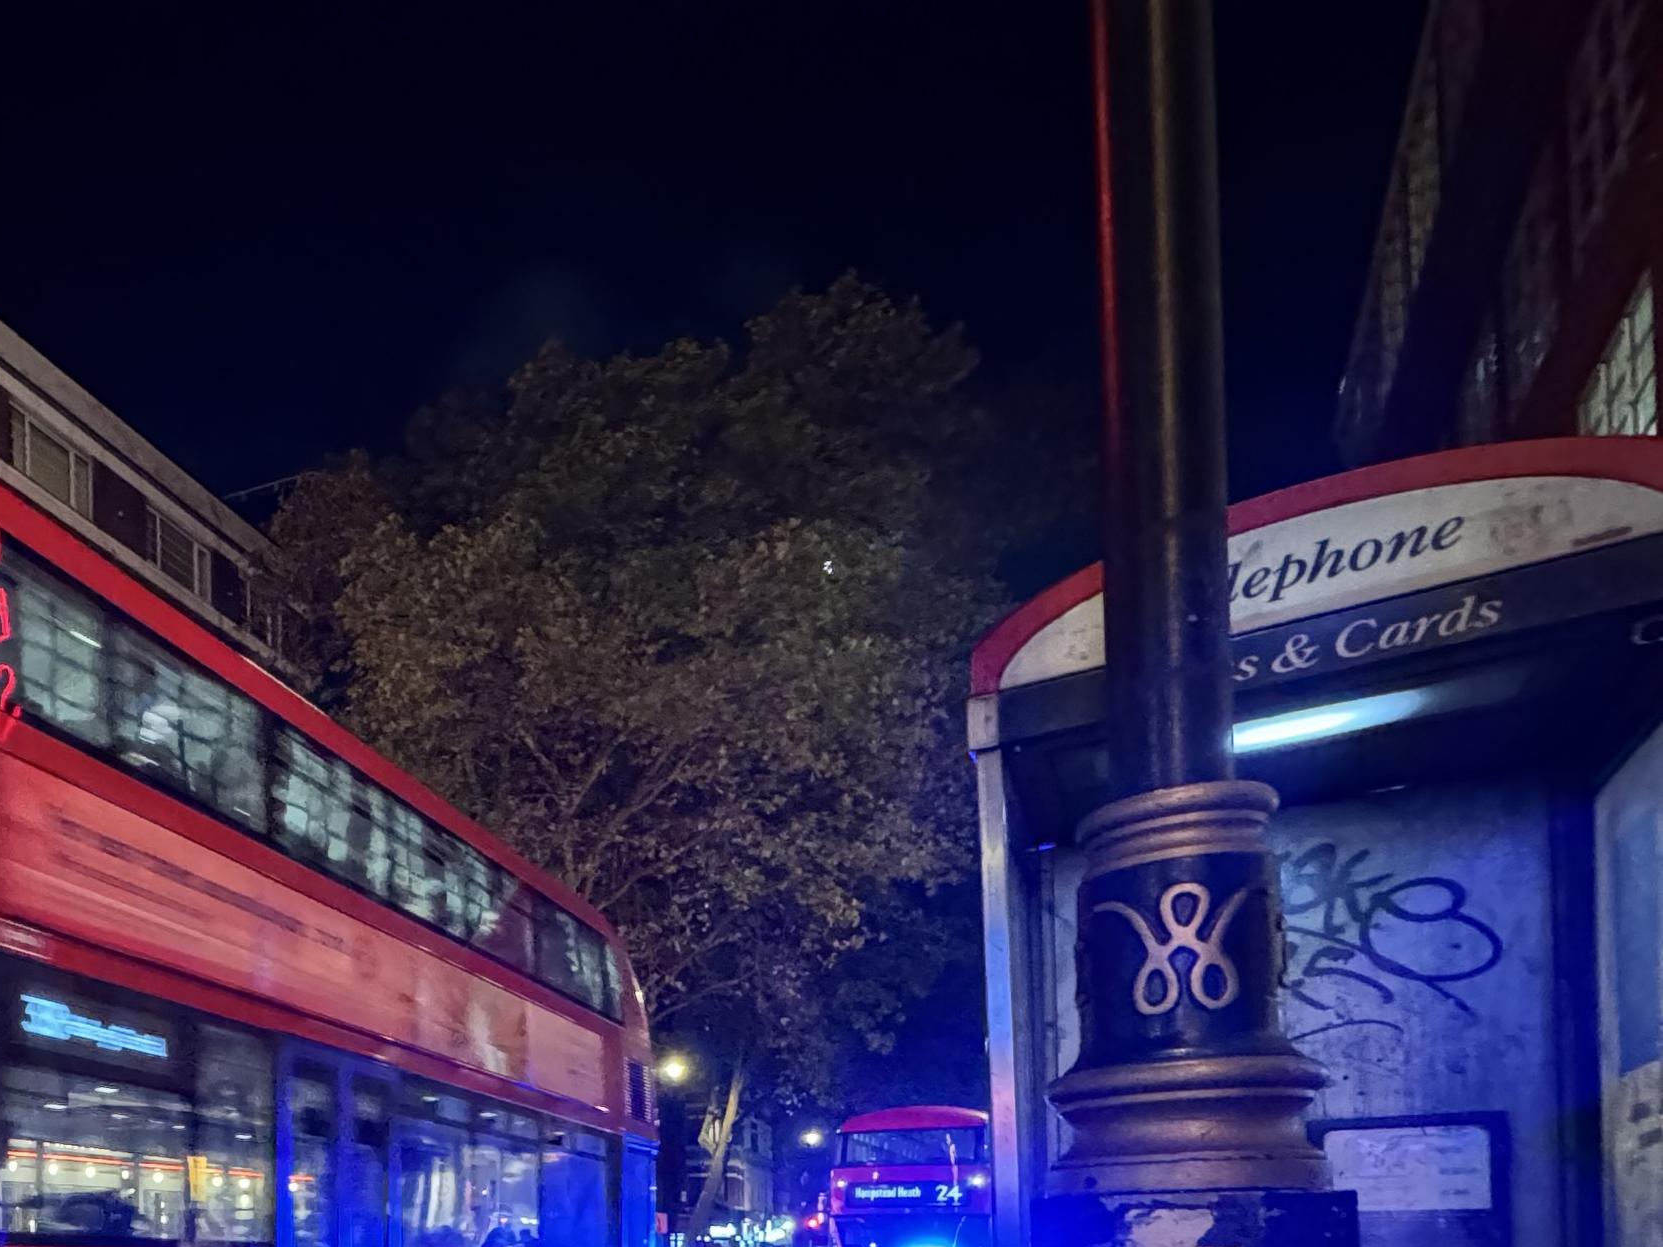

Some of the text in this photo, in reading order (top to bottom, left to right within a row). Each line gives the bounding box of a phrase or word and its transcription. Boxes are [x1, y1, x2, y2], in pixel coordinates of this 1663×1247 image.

[1270, 633, 1320, 674] &
[1334, 595, 1504, 659] Cards
[854, 1185, 922, 1201] Hampstead Heath
[935, 1184, 963, 1203] 24
